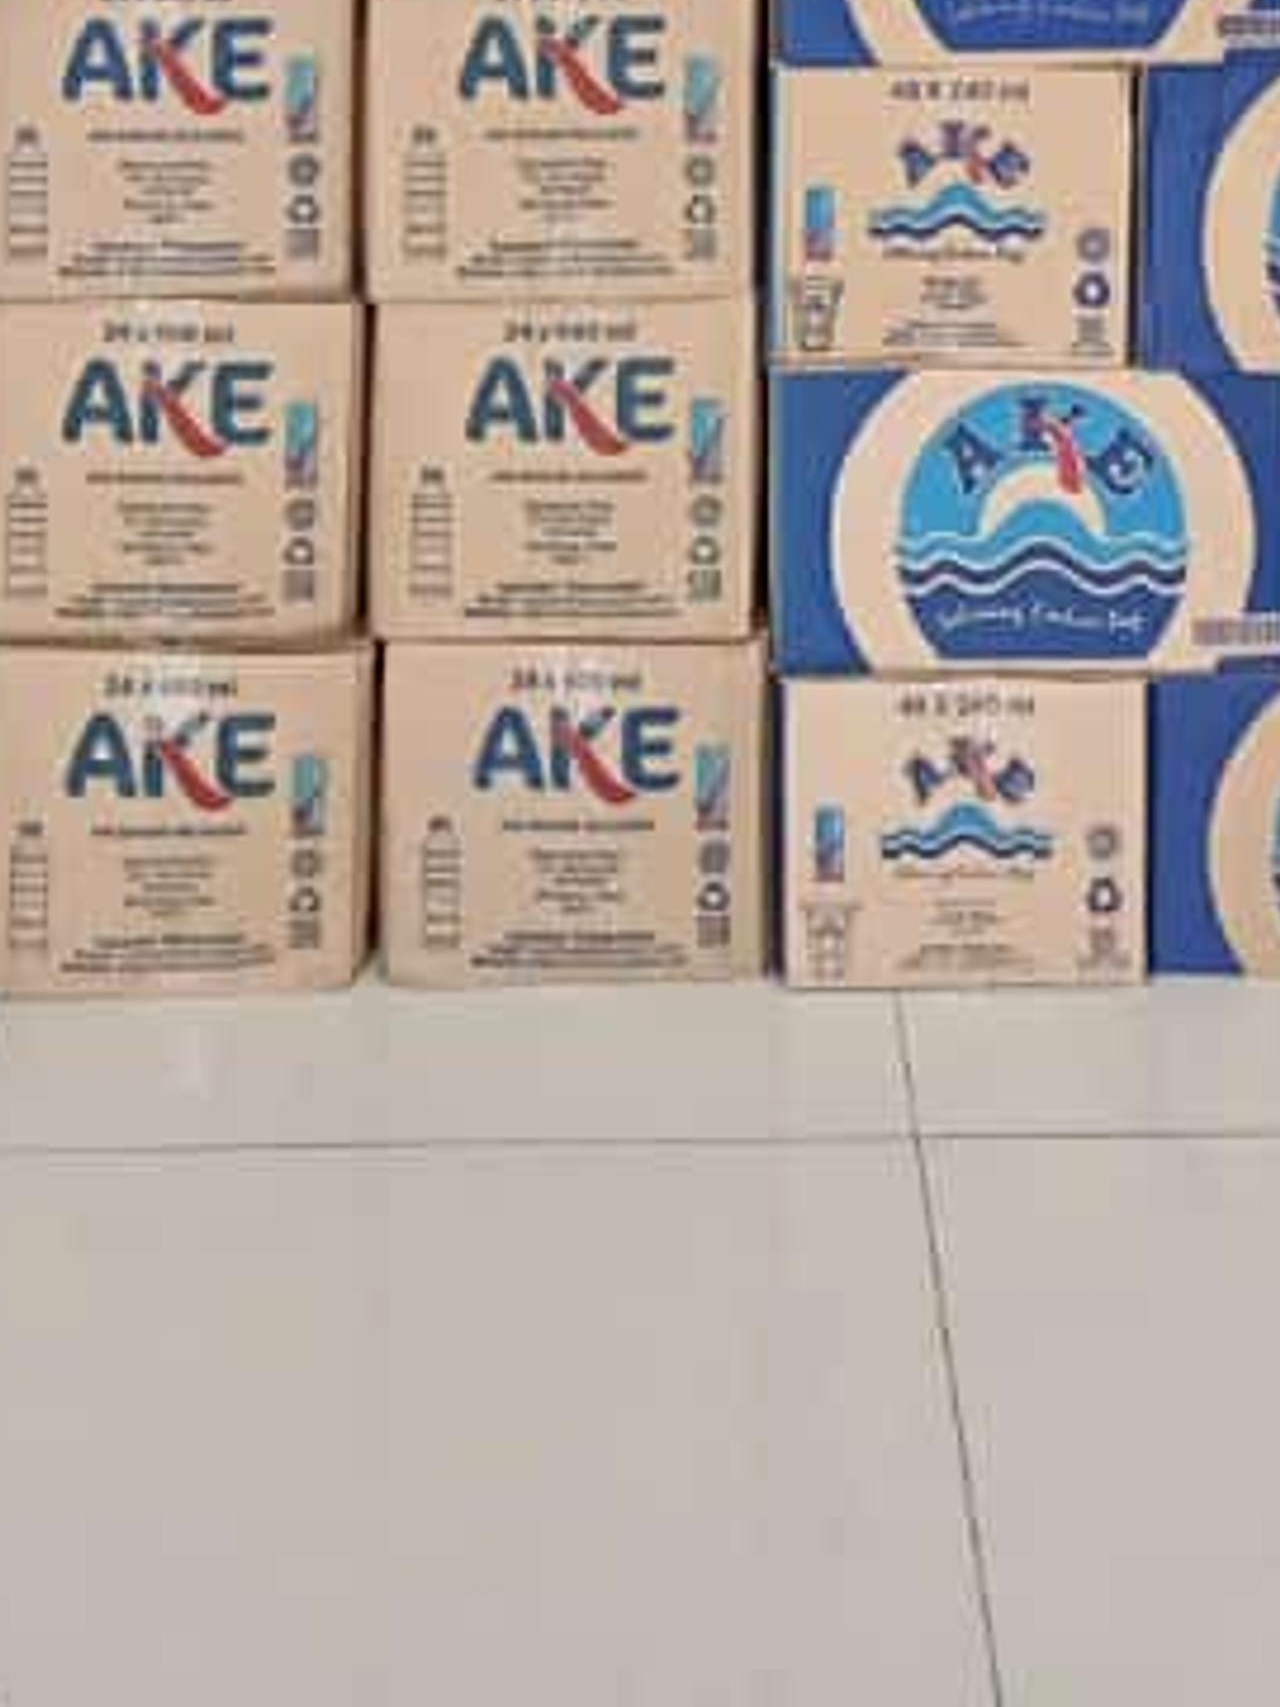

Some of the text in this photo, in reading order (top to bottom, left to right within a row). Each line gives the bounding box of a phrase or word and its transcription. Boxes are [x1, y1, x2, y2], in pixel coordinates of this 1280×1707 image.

[61, 17, 273, 116] AKE
[458, 14, 665, 116] AKE
[61, 358, 275, 458] AKE
[465, 356, 676, 456] AKE
[942, 396, 1156, 496] AKE
[65, 712, 277, 813] AKE
[473, 705, 681, 804] AKE
